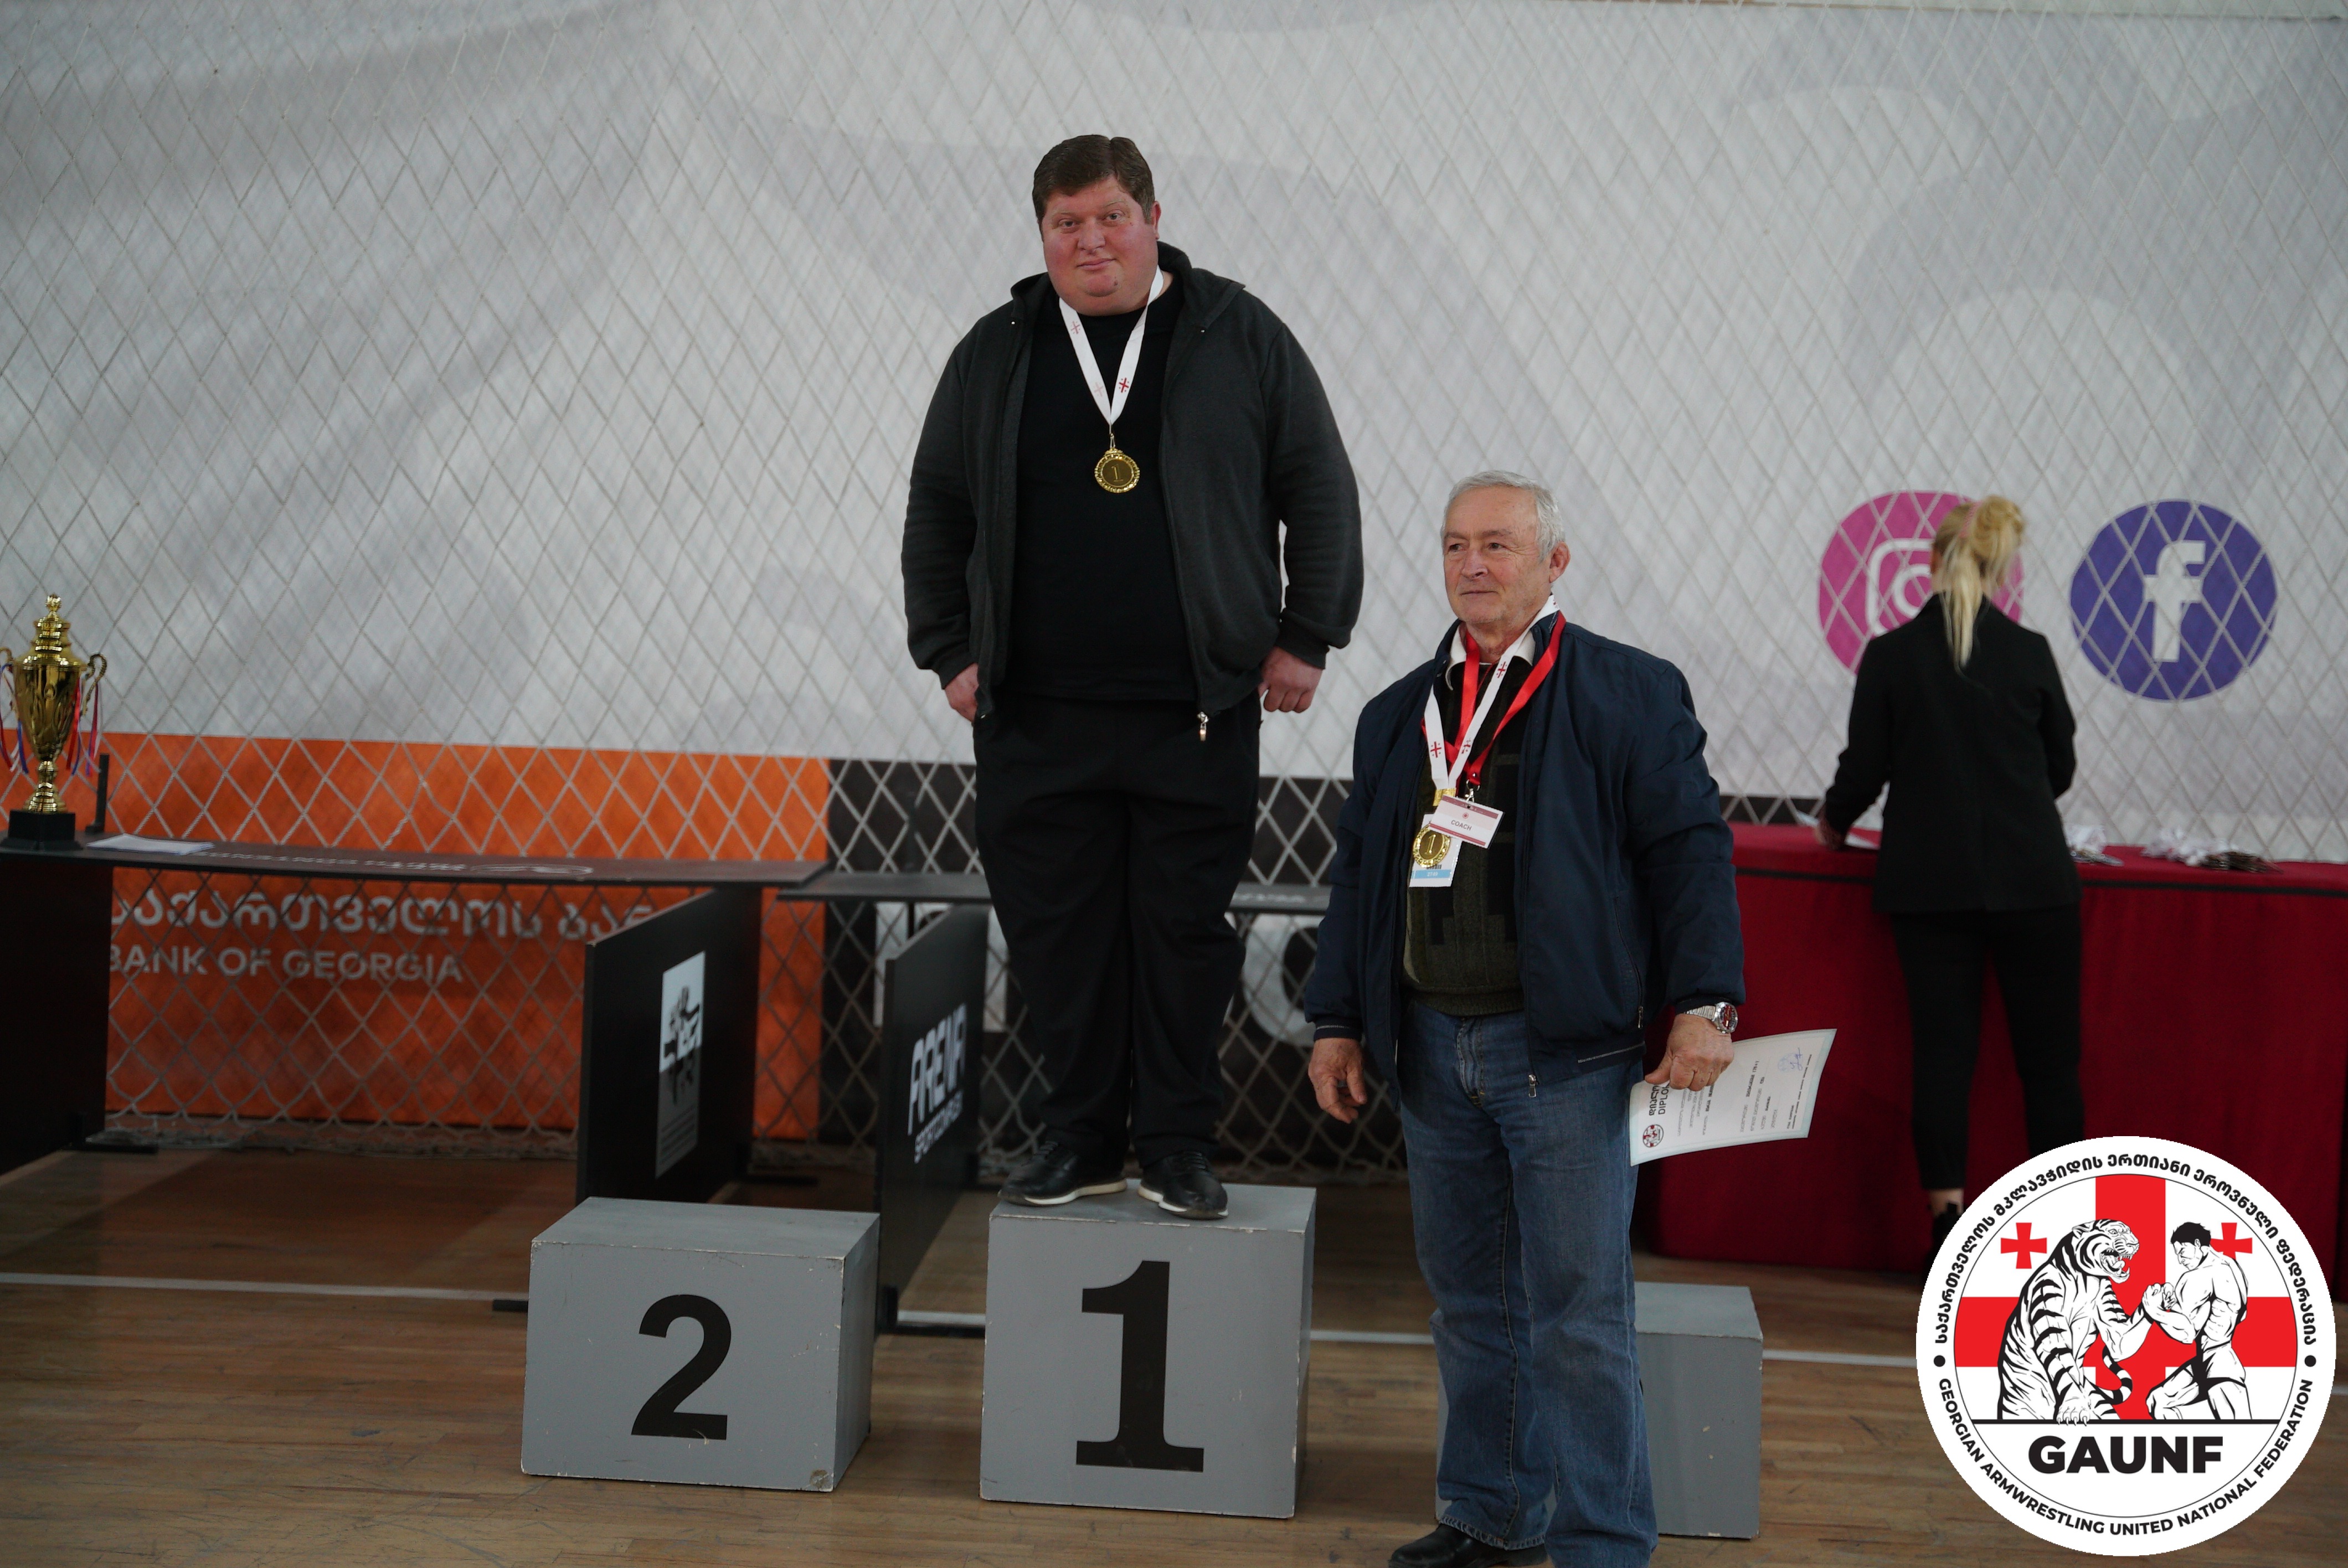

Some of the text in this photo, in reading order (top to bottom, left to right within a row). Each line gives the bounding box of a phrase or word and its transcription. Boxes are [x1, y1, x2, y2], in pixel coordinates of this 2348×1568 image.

[1451, 819, 1472, 831] COACH
[1424, 834, 1436, 855] 1
[110, 944, 464, 984] BANK OF GEORGIA
[1649, 1085, 1660, 1116] დიპლო
[631, 1294, 731, 1440] 2
[1075, 1260, 1204, 1472] 1
